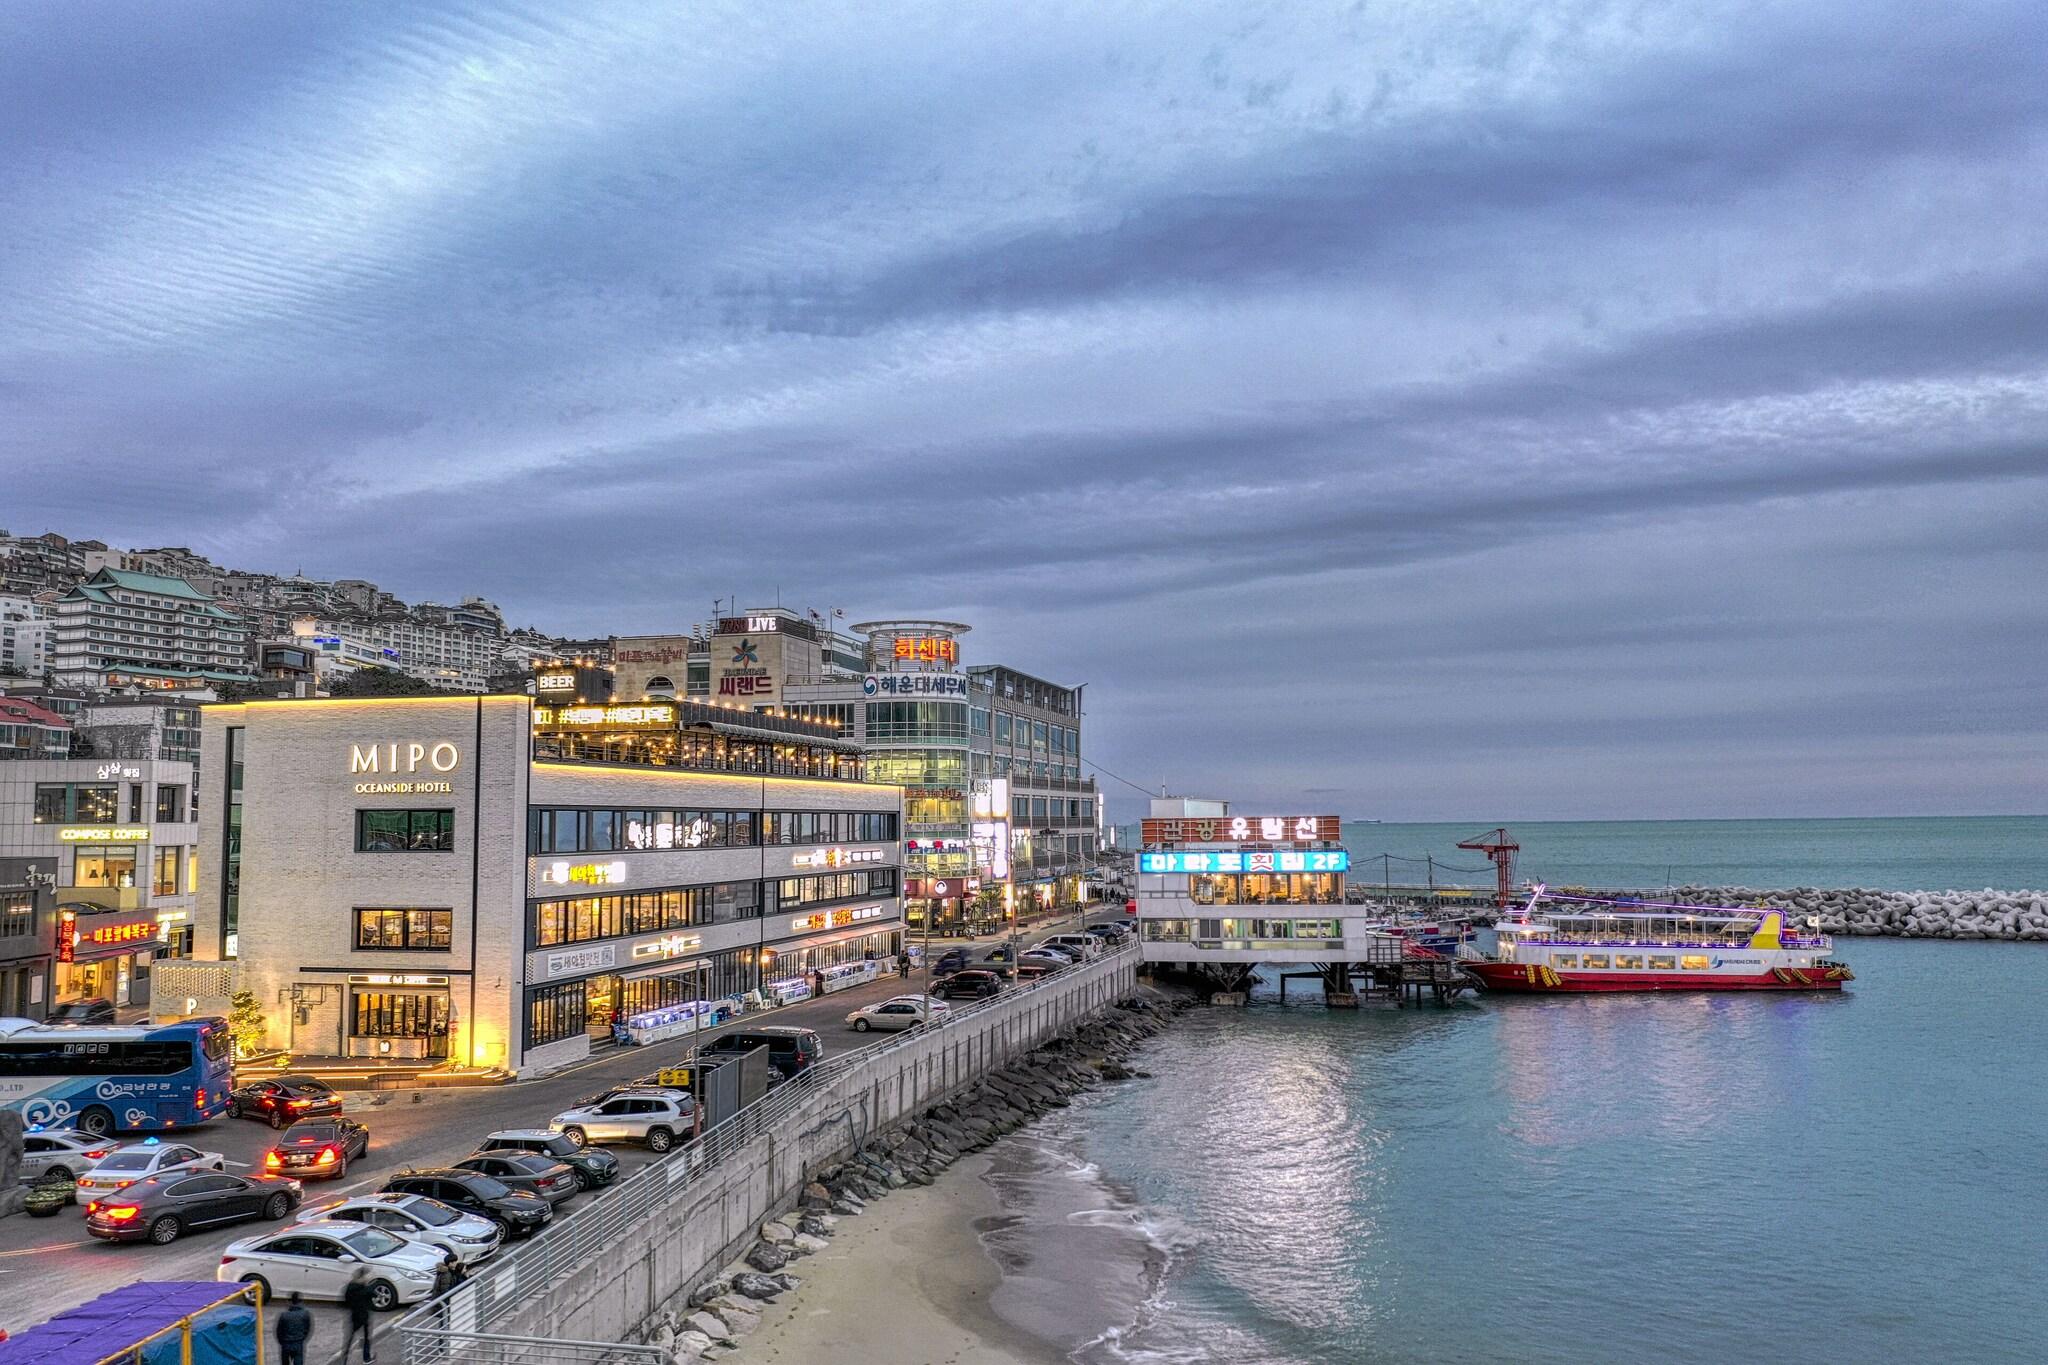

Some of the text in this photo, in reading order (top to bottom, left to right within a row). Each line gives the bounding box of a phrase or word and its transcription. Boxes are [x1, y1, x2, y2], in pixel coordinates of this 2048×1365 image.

[748, 617, 776, 631] LIVE
[895, 638, 954, 661] 회센터
[539, 675, 575, 688] BEER
[718, 676, 773, 696] 씨랜드
[351, 743, 459, 773] MIPO
[355, 782, 452, 793] OCEANSIDE HOTEL
[61, 829, 150, 840] COMPOSE COFFEE
[1229, 817, 1318, 840] 유람선
[1313, 855, 1340, 871] 2F
[187, 998, 197, 1014] P
